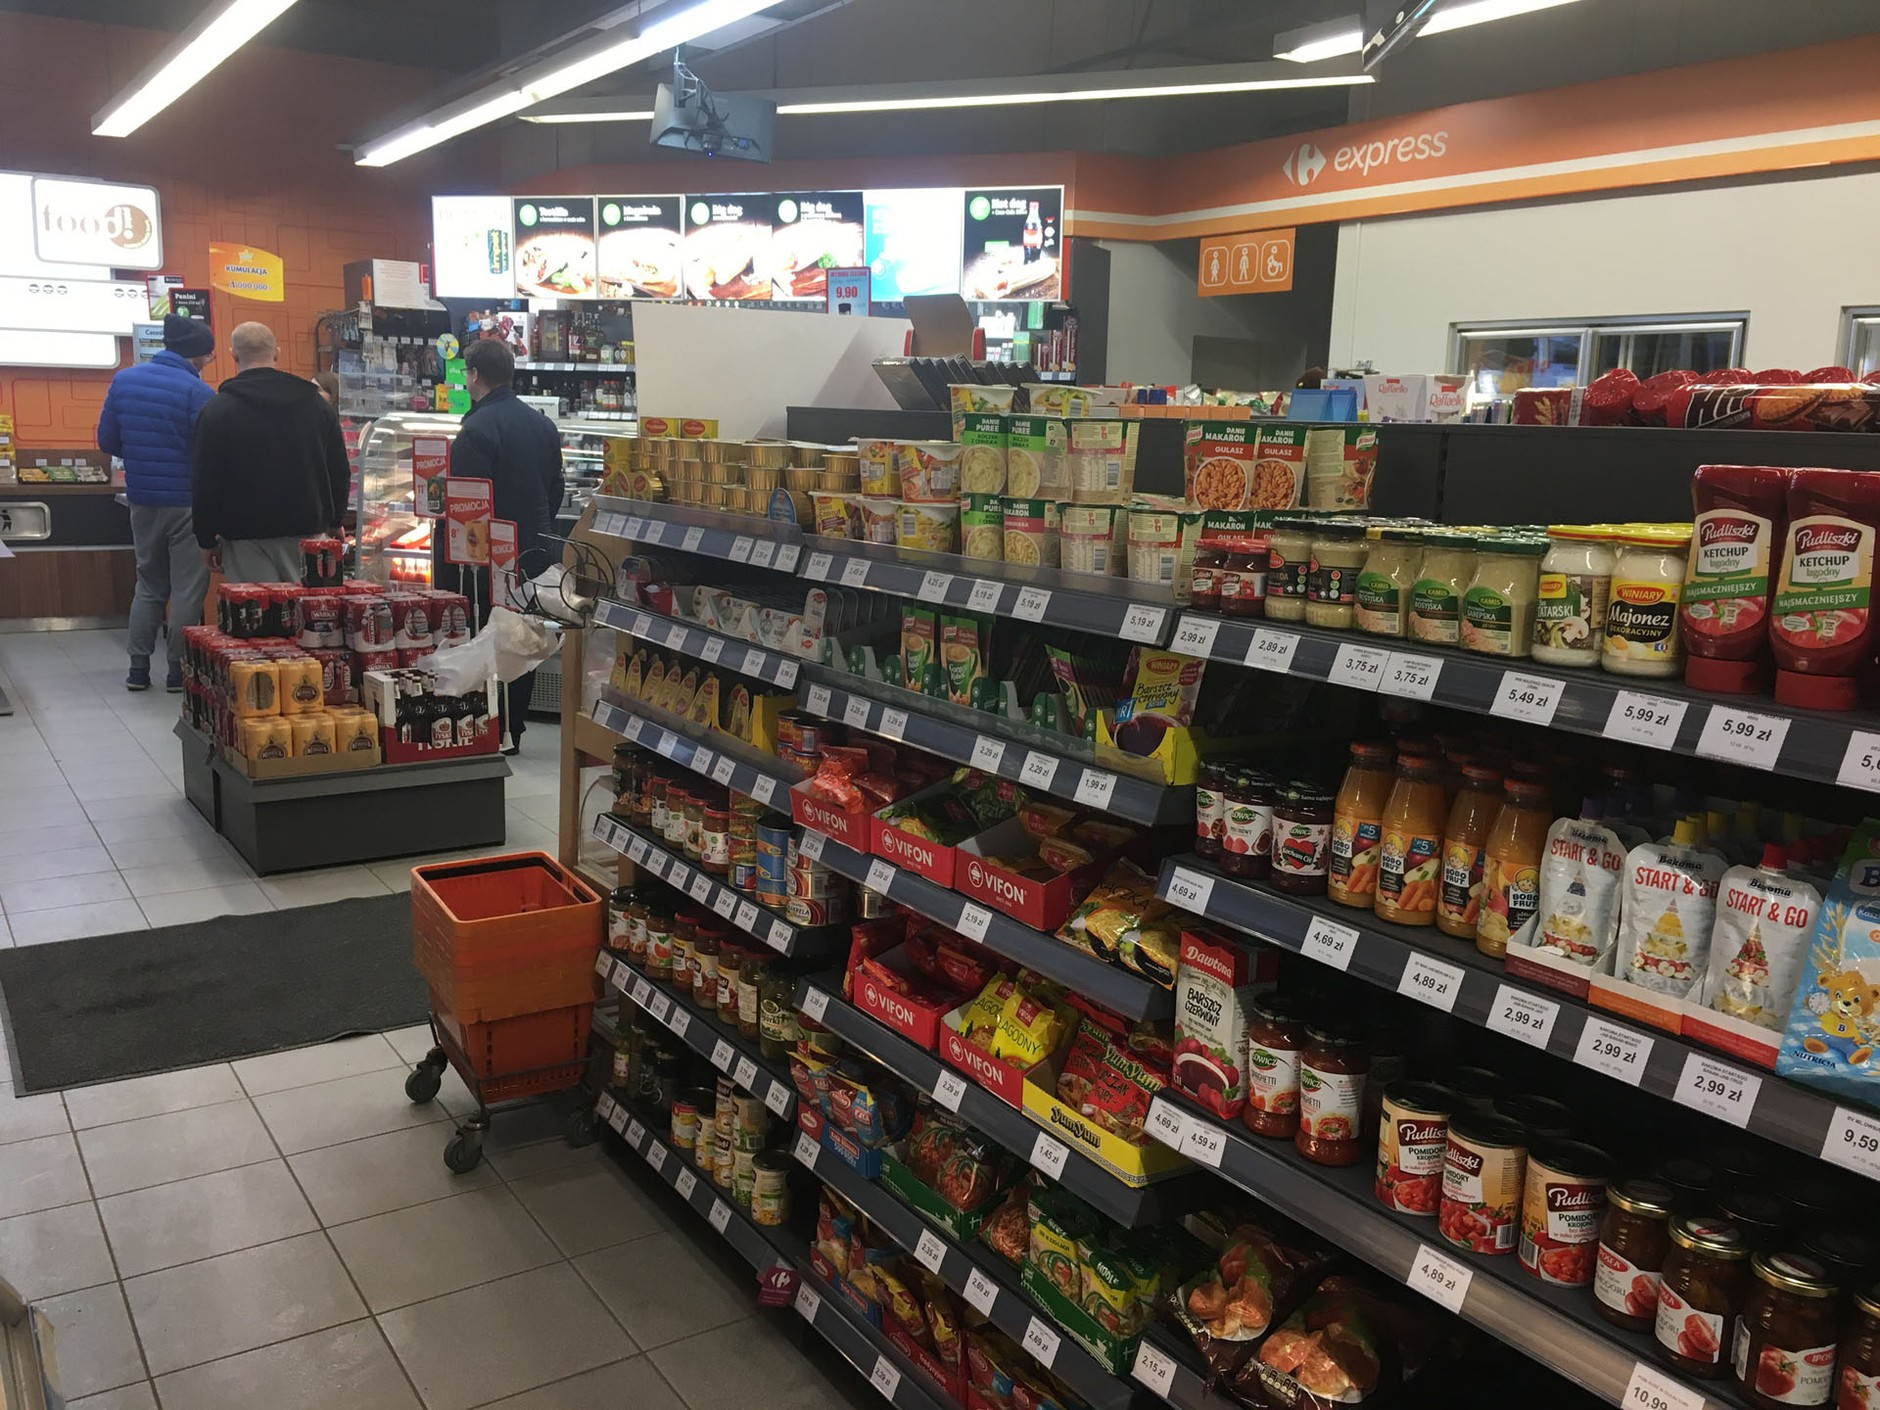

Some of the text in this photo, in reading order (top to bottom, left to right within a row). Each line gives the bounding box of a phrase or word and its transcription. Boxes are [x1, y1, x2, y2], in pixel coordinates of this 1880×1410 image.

[1333, 130, 1449, 176] express
[225, 265, 267, 276] KUMULACJA
[174, 292, 196, 300] Panini
[835, 286, 858, 299] 9,90
[1378, 384, 1408, 395] Raffaello
[1430, 393, 1465, 407] Raffaello
[976, 425, 1000, 433] PUREE
[1226, 427, 1245, 435] DANIE
[1205, 433, 1245, 443] MAKARON
[1261, 435, 1294, 445] AKARON
[1214, 446, 1244, 454] GULASZ
[1264, 448, 1292, 456] GULASZ
[449, 500, 490, 514] PROMOCJA
[1207, 521, 1246, 531] MAKARON
[1701, 522, 1756, 541] Pudliszki
[1796, 529, 1858, 549] Pudliszki
[1703, 546, 1749, 558] KETCHUP
[1799, 555, 1850, 567] KETCHUP
[986, 591, 993, 600] zł
[1621, 588, 1663, 600] WINIARY
[1686, 582, 1757, 597] NAJSMACZNIEJSZY
[1020, 599, 1042, 610] 5,19 zł
[1778, 593, 1857, 608] NAJSMACZNIEJSZY
[1537, 605, 1574, 617] TATARSKI
[1608, 605, 1670, 627] Majonez
[1130, 616, 1155, 629] 5,19 zł
[1180, 631, 1207, 645] 2,99 zł
[1610, 626, 1662, 637] DEKORACYJNY
[1258, 640, 1288, 655] 2,89 zł
[1345, 658, 1379, 674] 3,75 zł
[1394, 670, 1429, 686] 3,75 zł
[1136, 682, 1173, 694] Barszcz
[1137, 689, 1180, 704] czerwony
[1508, 689, 1549, 707] 5,49 zł
[1624, 705, 1670, 726] 5,99 zł
[1722, 719, 1773, 742] 5,99 zł
[980, 745, 999, 759] 2,29 zł
[1027, 763, 1049, 777] 2,29 zł
[1085, 778, 1107, 791] 1,99 zł
[814, 806, 848, 833] VIFON
[896, 840, 933, 867] VIFON
[1382, 855, 1402, 866] BOBO
[1551, 838, 1621, 872] START & GO
[1382, 862, 1401, 872] FRUT
[1657, 855, 1703, 870] Bakoma
[1445, 868, 1467, 880] BOBO
[1445, 875, 1465, 885] FRUT
[1635, 867, 1680, 892] START
[1682, 875, 1694, 895] &
[985, 871, 1025, 905] VIFON
[1171, 883, 1197, 900] 4,69 zł
[1750, 877, 1792, 897] Bakoma
[1512, 893, 1539, 901] BOBO
[1512, 900, 1537, 908] FRUT
[1726, 888, 1809, 928] START & GO
[965, 912, 984, 926] 2,19 zł
[1313, 930, 1345, 952] 4,69 zł
[1187, 946, 1232, 979] Dawtona
[1412, 972, 1448, 995] 4,89 zł
[878, 993, 914, 1026] VIFON
[1187, 988, 1222, 1016] BARSZCZ
[1185, 1001, 1220, 1027] CZERWONY
[1504, 1007, 1544, 1030] 2,99 zł
[1592, 1039, 1637, 1064] 2,99 zł
[963, 1049, 1003, 1085] VIFON
[1794, 1050, 1836, 1069] NUTRICIA
[954, 1088, 960, 1097] zł
[1694, 1075, 1743, 1102] 2,99 zł
[1050, 1105, 1101, 1148] YumYum
[1155, 1113, 1180, 1134] 4,69 zł
[1191, 1132, 1218, 1150] 4,59 zł
[1843, 1129, 1880, 1152] 9,59
[1039, 1146, 1060, 1164] 1,45 zł
[1448, 1148, 1480, 1170] dliszki
[932, 1253, 938, 1262] zł
[1421, 1264, 1456, 1291] 4,89 zł
[971, 1276, 991, 1299] 2,69 zł
[1028, 1330, 1049, 1352] 2,69 zł
[1141, 1355, 1167, 1379] 2,15 zł
[1633, 1385, 1668, 1410] 10,99
